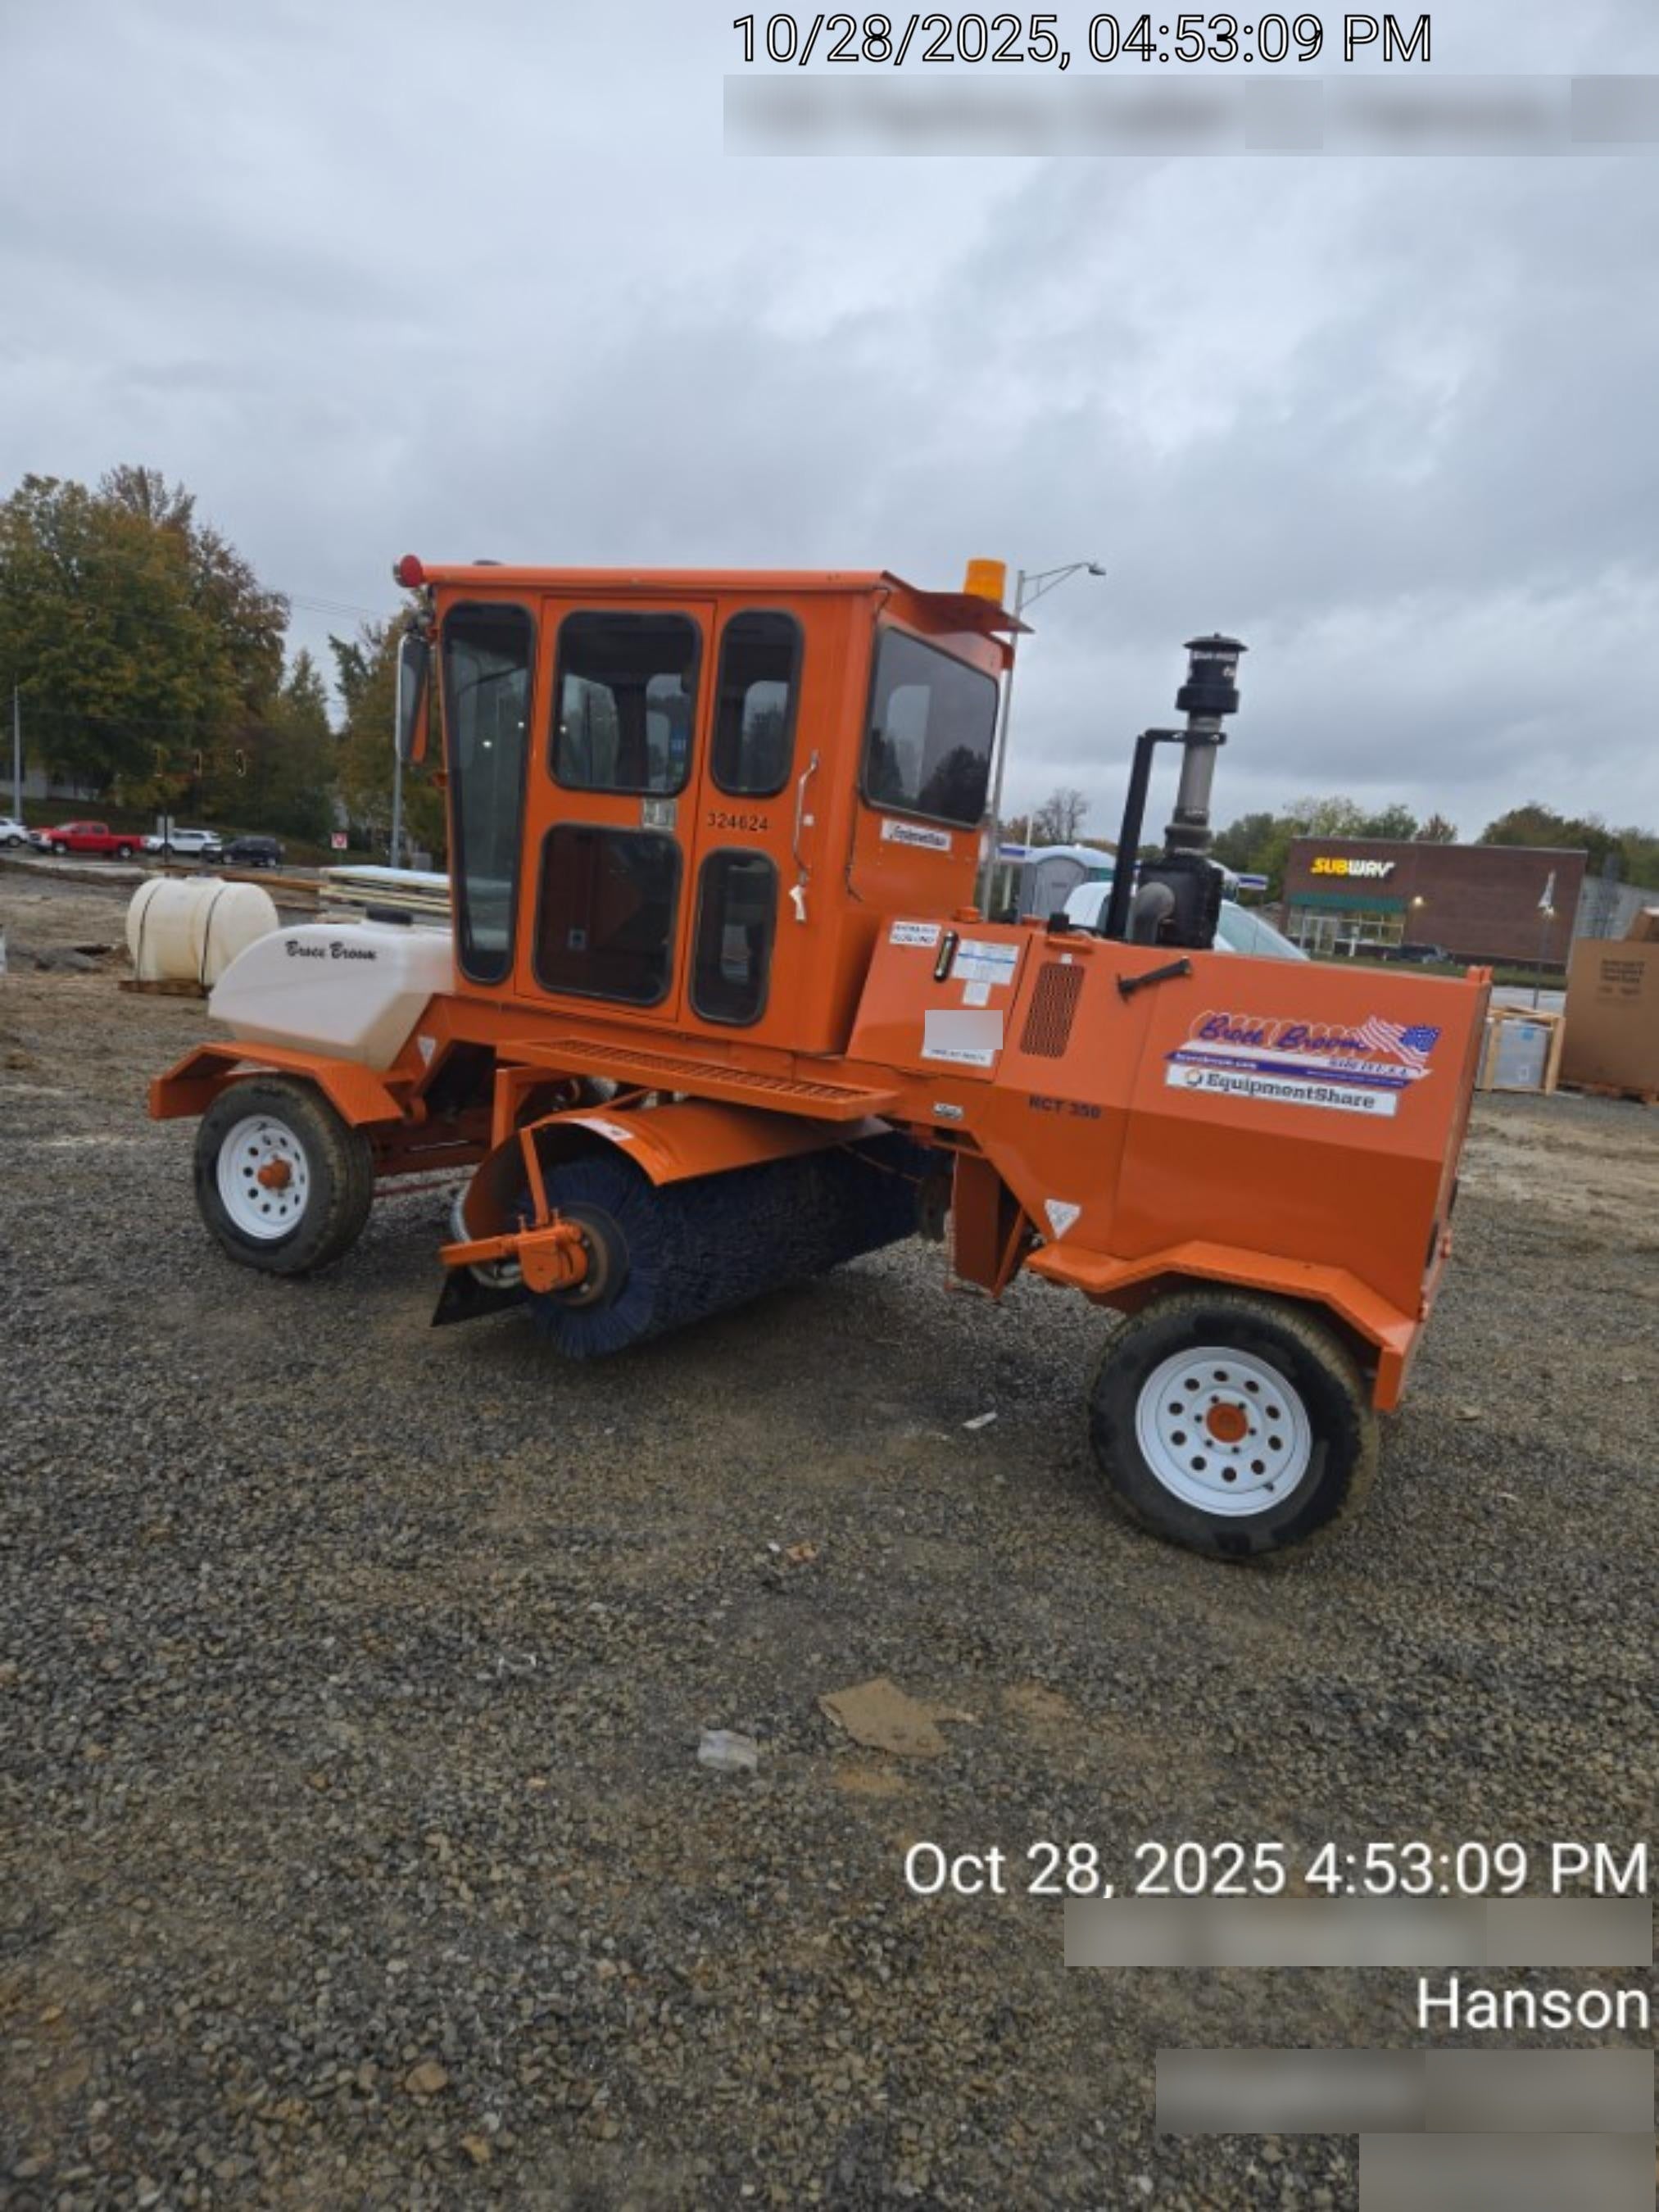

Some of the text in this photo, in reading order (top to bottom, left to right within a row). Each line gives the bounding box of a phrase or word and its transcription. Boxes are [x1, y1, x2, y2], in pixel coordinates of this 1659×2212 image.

[708, 813, 768, 832] 324624
[1311, 858, 1395, 877] SUBWAY
[1206, 1072, 1376, 1108] EquipmentShare
